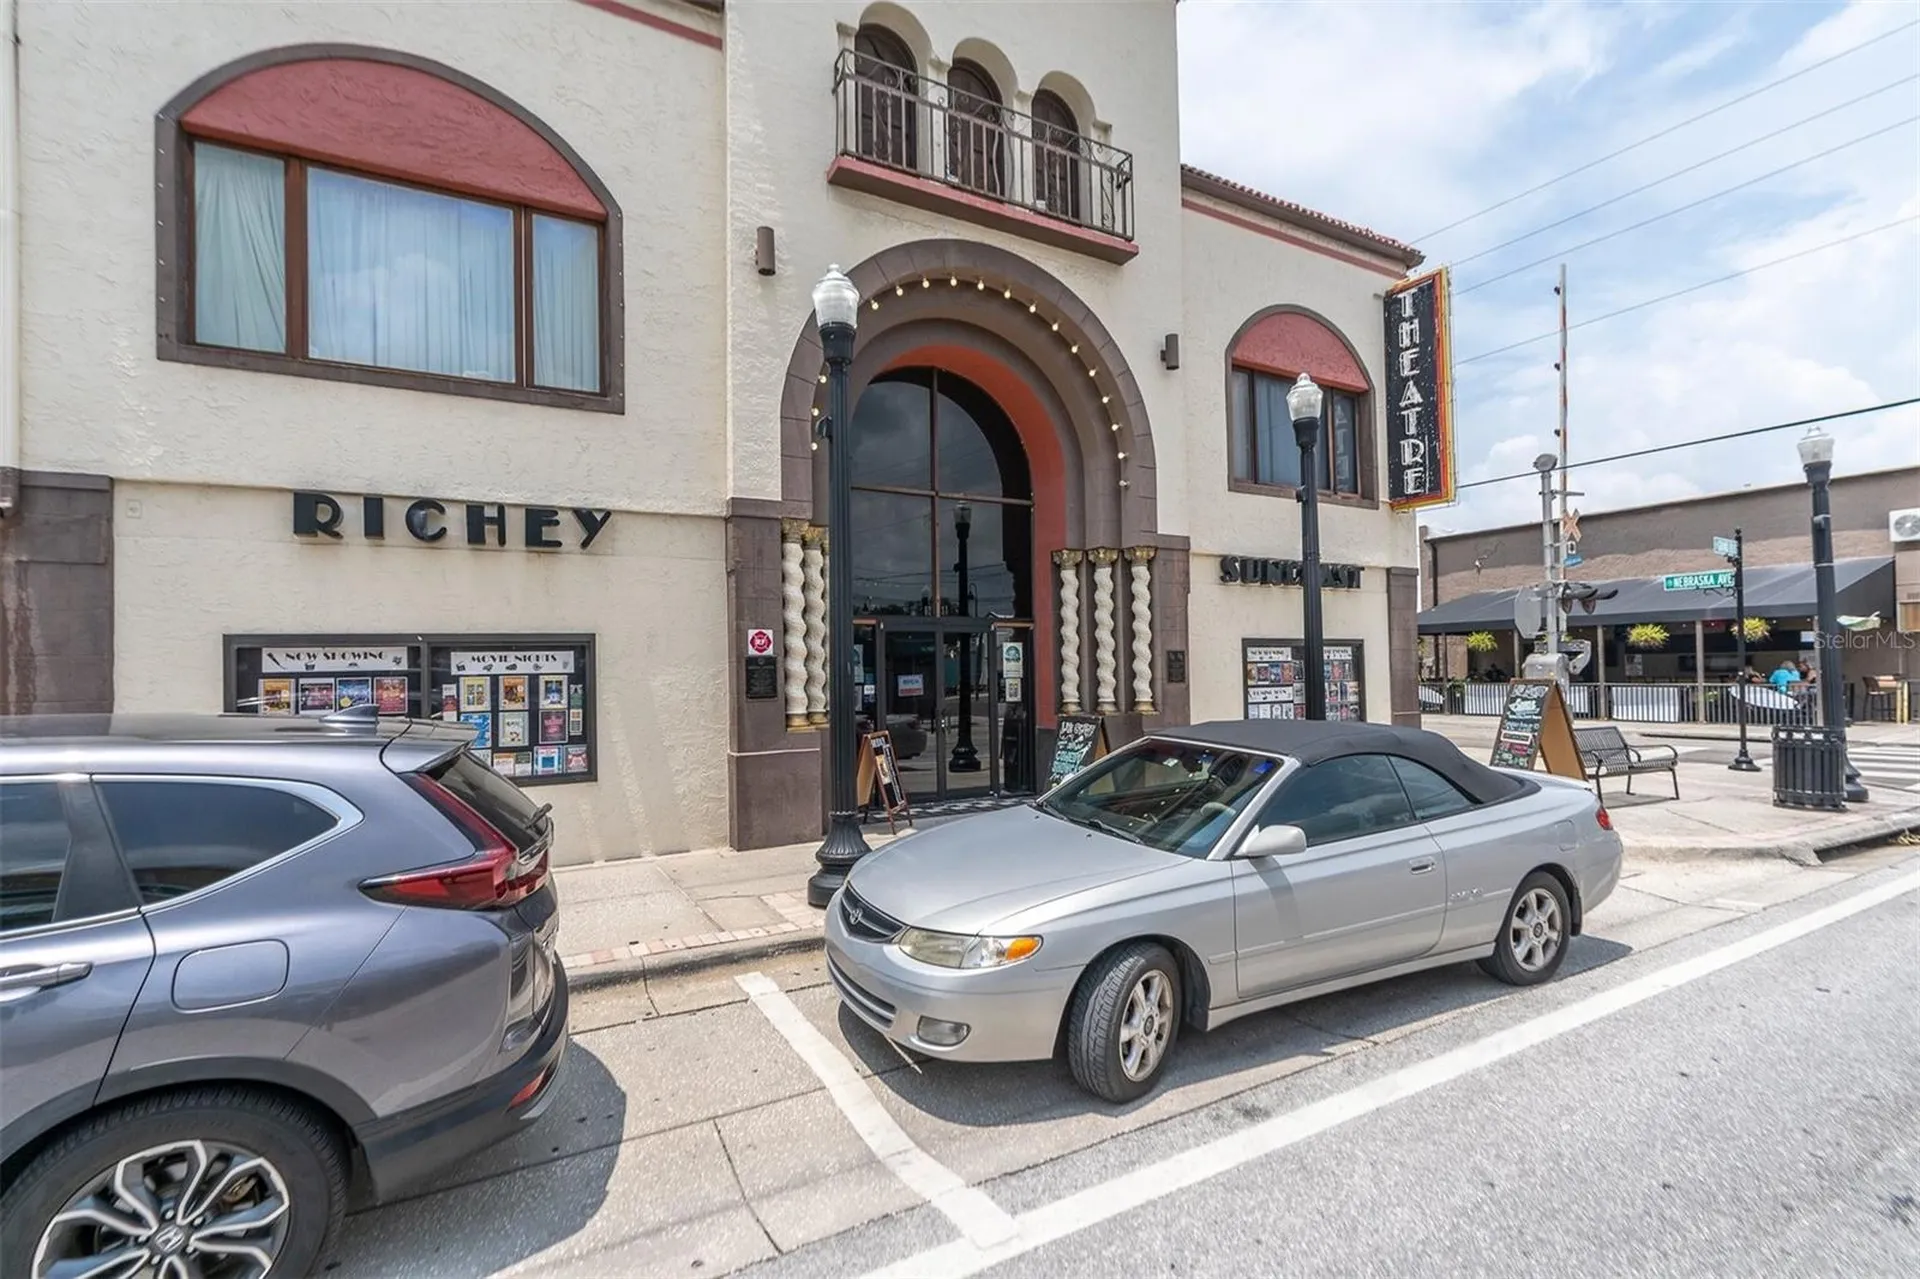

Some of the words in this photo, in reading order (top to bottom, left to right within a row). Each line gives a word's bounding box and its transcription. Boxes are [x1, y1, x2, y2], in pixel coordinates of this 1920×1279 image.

[1398, 288, 1425, 495] THEATRE
[293, 491, 612, 549] RICHEY
[1220, 556, 1365, 589] SUNCAST
[1673, 574, 1715, 588] NEBRASKA
[1717, 572, 1733, 586] AVE
[284, 651, 318, 661] NOW
[322, 650, 387, 661] SHOWING
[471, 654, 510, 663] MOVIE
[514, 653, 558, 663] NIGHTS
